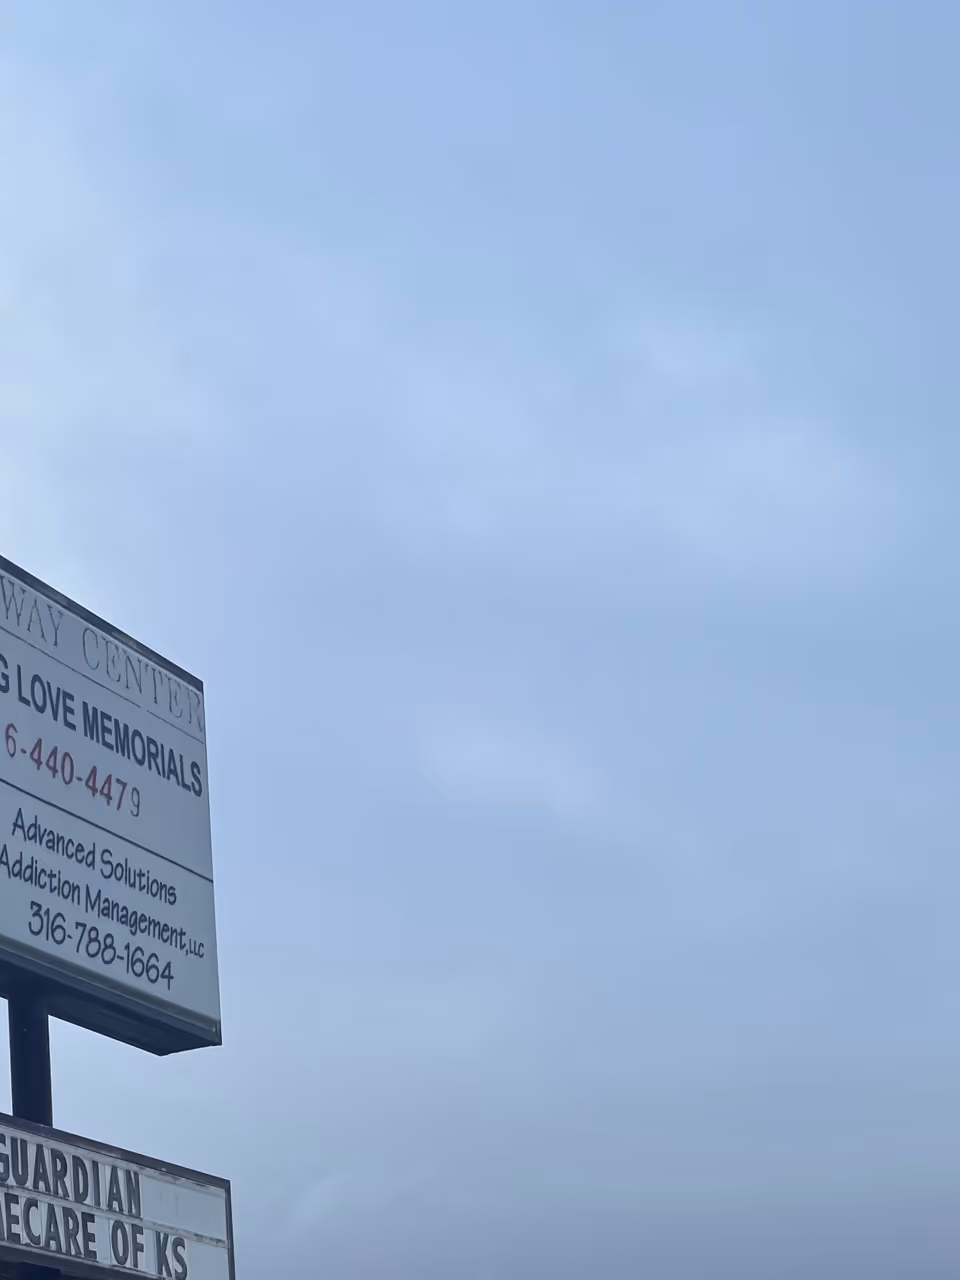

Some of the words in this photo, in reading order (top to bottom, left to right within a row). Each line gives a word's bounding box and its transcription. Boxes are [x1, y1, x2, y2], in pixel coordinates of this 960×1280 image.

[81, 627, 204, 733] CENTER
[17, 664, 77, 732] LOVE
[81, 701, 203, 798] MEMORIALS
[12, 807, 96, 870] Advanced
[100, 849, 177, 905] Solutions
[28, 900, 174, 990] 316-788-1664
[110, 1220, 145, 1269] OF
